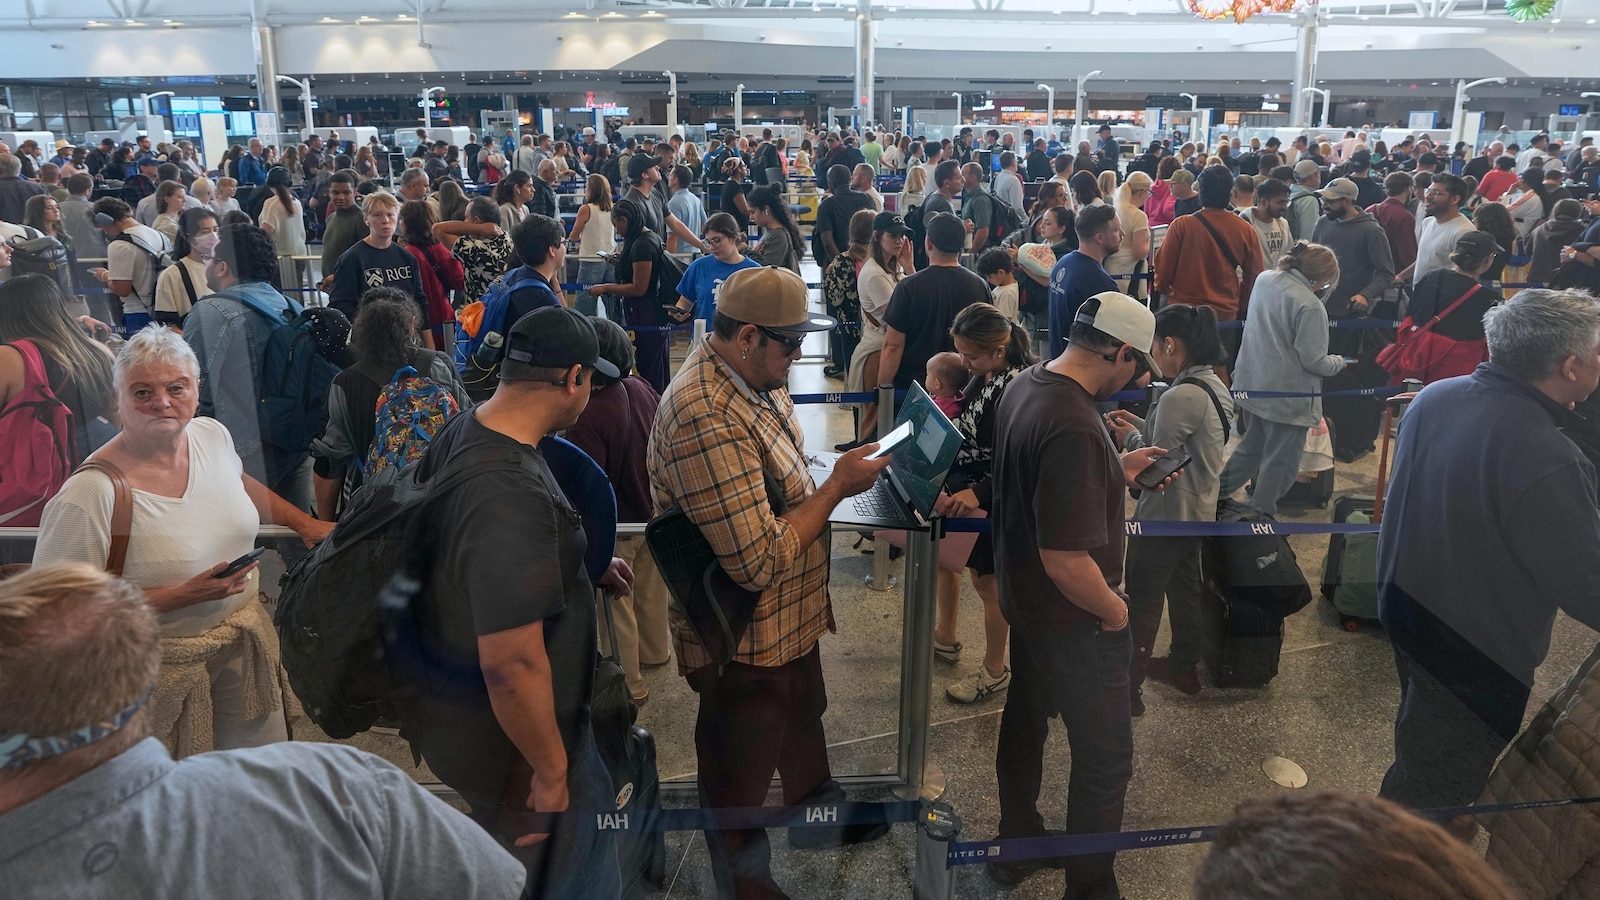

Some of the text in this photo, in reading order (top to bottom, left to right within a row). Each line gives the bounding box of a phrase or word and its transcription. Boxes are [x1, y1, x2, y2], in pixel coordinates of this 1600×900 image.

[385, 266, 412, 282] RICE
[115, 326, 127, 334] IAH
[825, 393, 842, 403] IAH
[1234, 391, 1249, 400] IAH
[1251, 523, 1275, 535] IAH
[806, 806, 838, 823] IAH
[597, 813, 629, 830] IAH
[1139, 833, 1188, 843] UNITED
